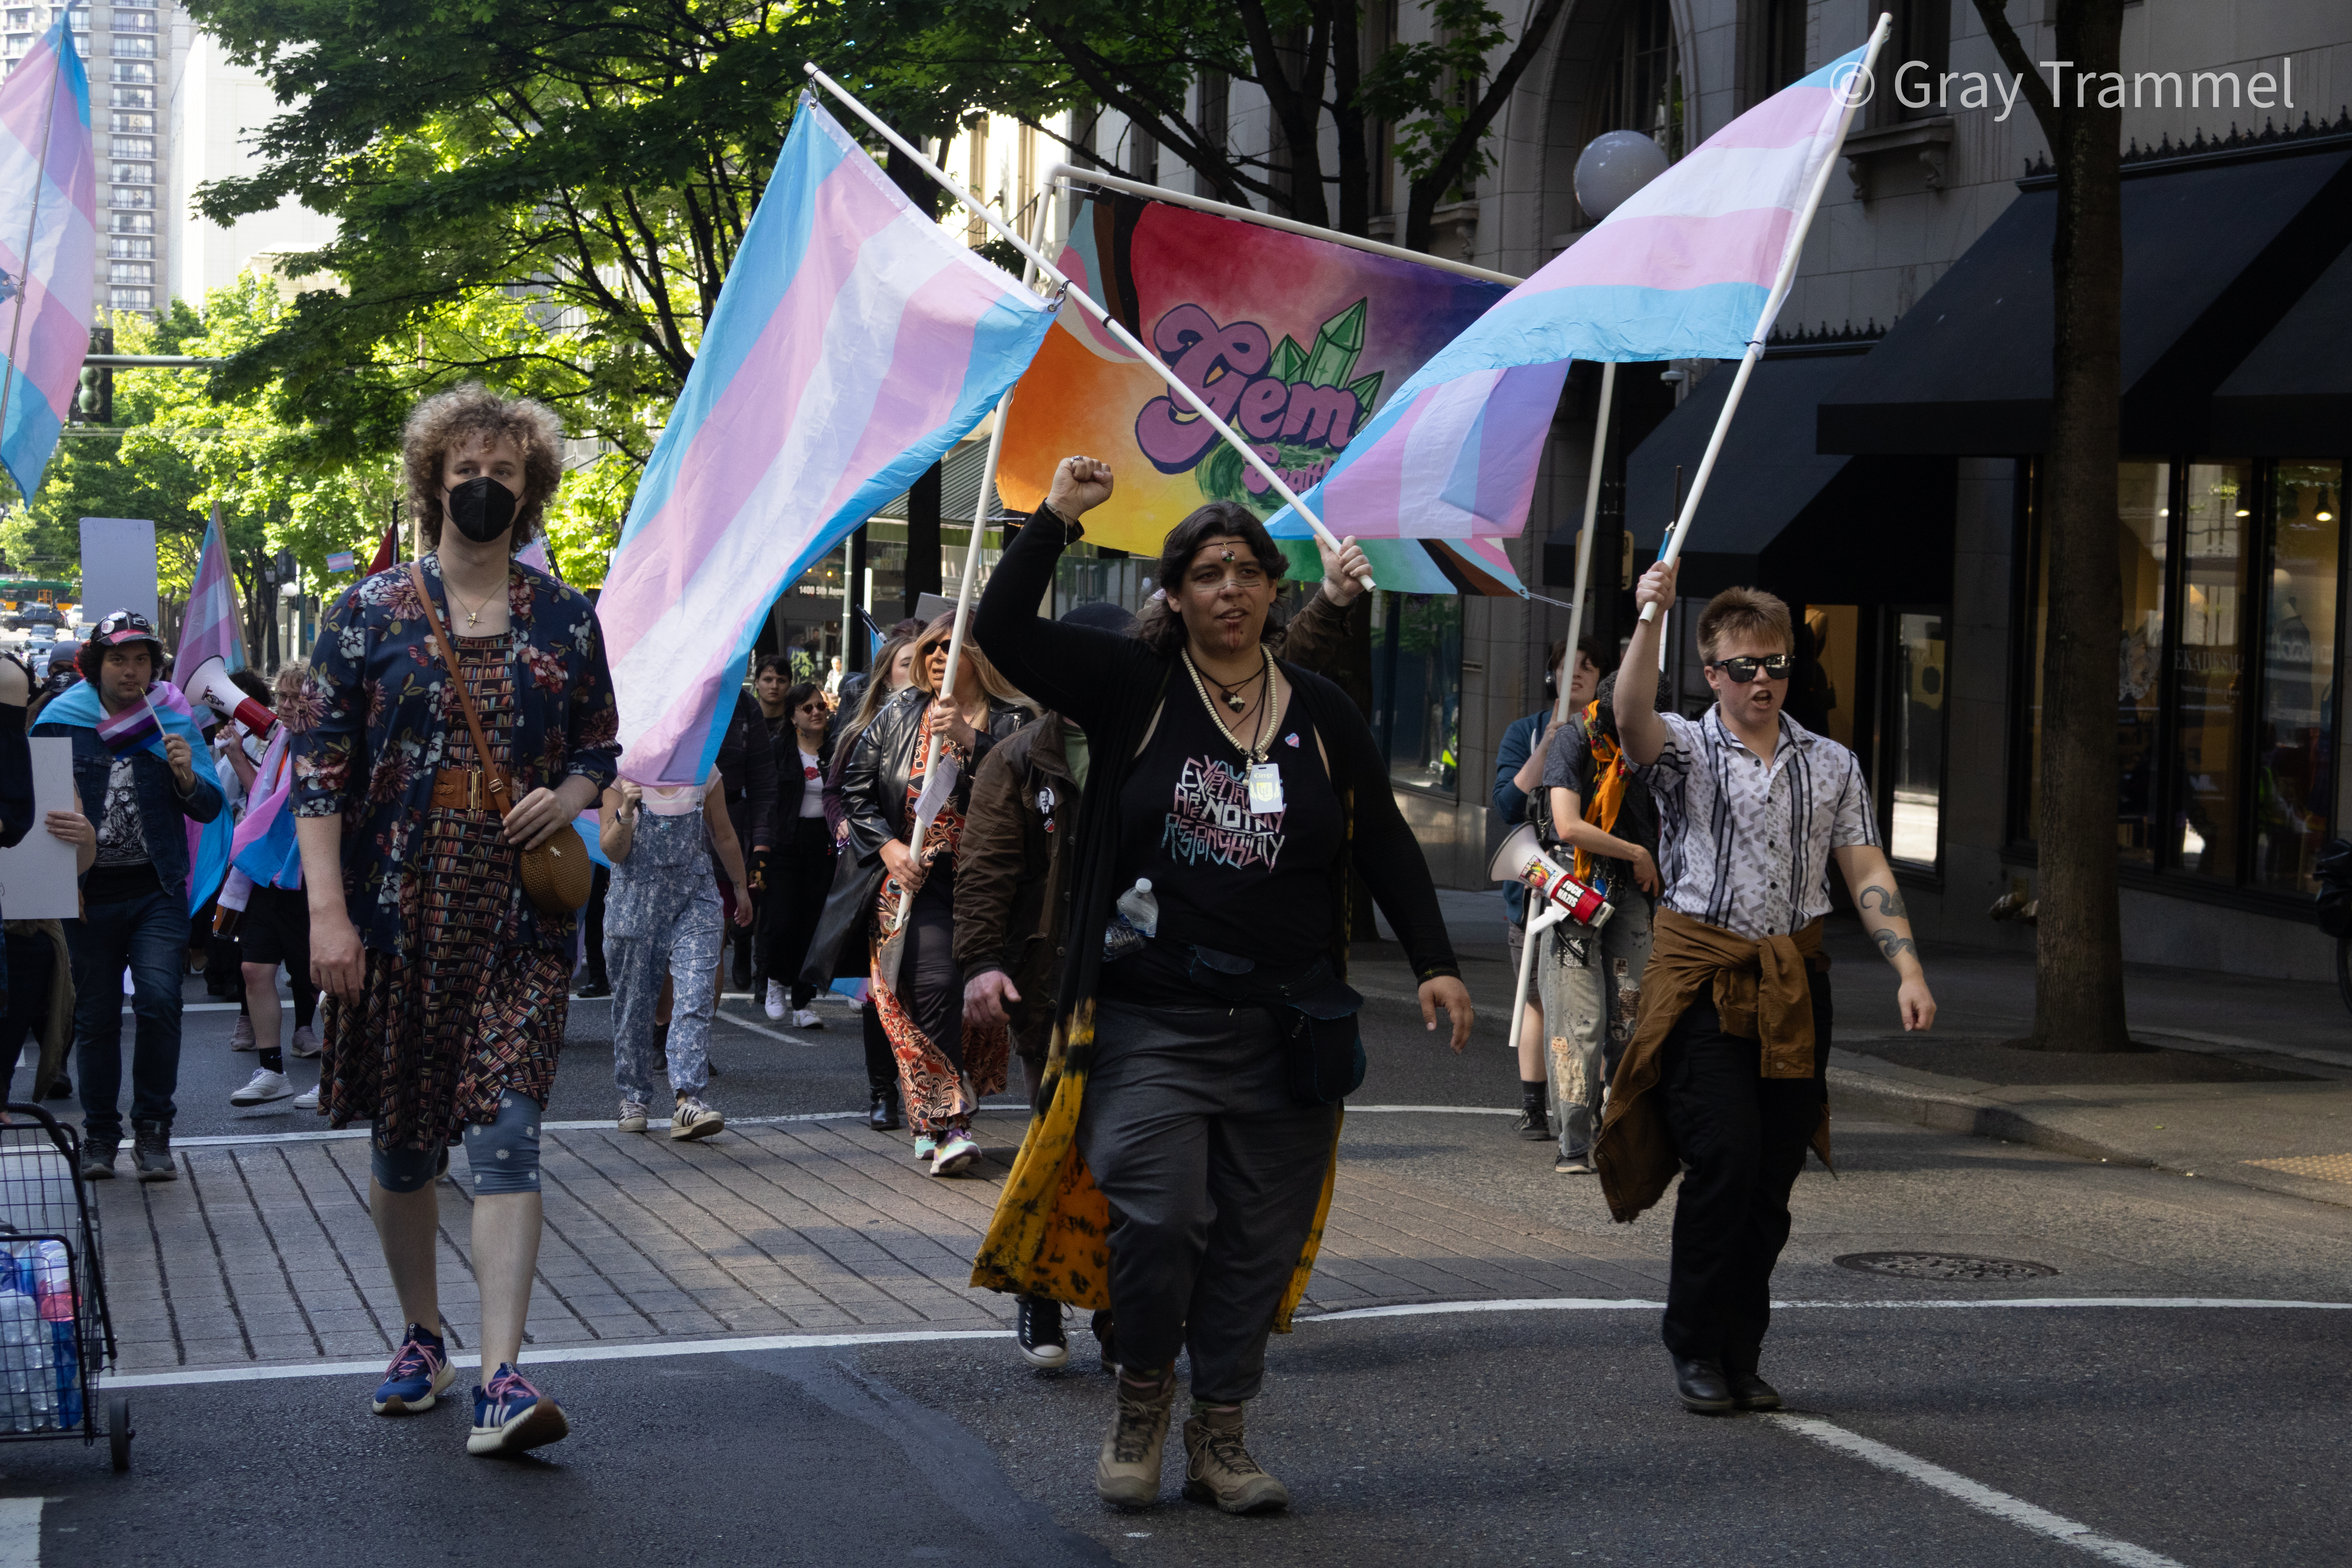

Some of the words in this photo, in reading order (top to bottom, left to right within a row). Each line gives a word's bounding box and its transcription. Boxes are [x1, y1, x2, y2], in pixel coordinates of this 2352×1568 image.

[1135, 303, 1363, 474] Gem
[1242, 443, 1330, 494] Seattl
[799, 585, 815, 594] 1400
[816, 586, 826, 595] 5th
[828, 587, 845, 596] Aven
[1203, 755, 1247, 782] YOU
[1200, 796, 1261, 831] NOT
[1556, 888, 1578, 907] NAZIS
[1562, 880, 1584, 898] FUCK
